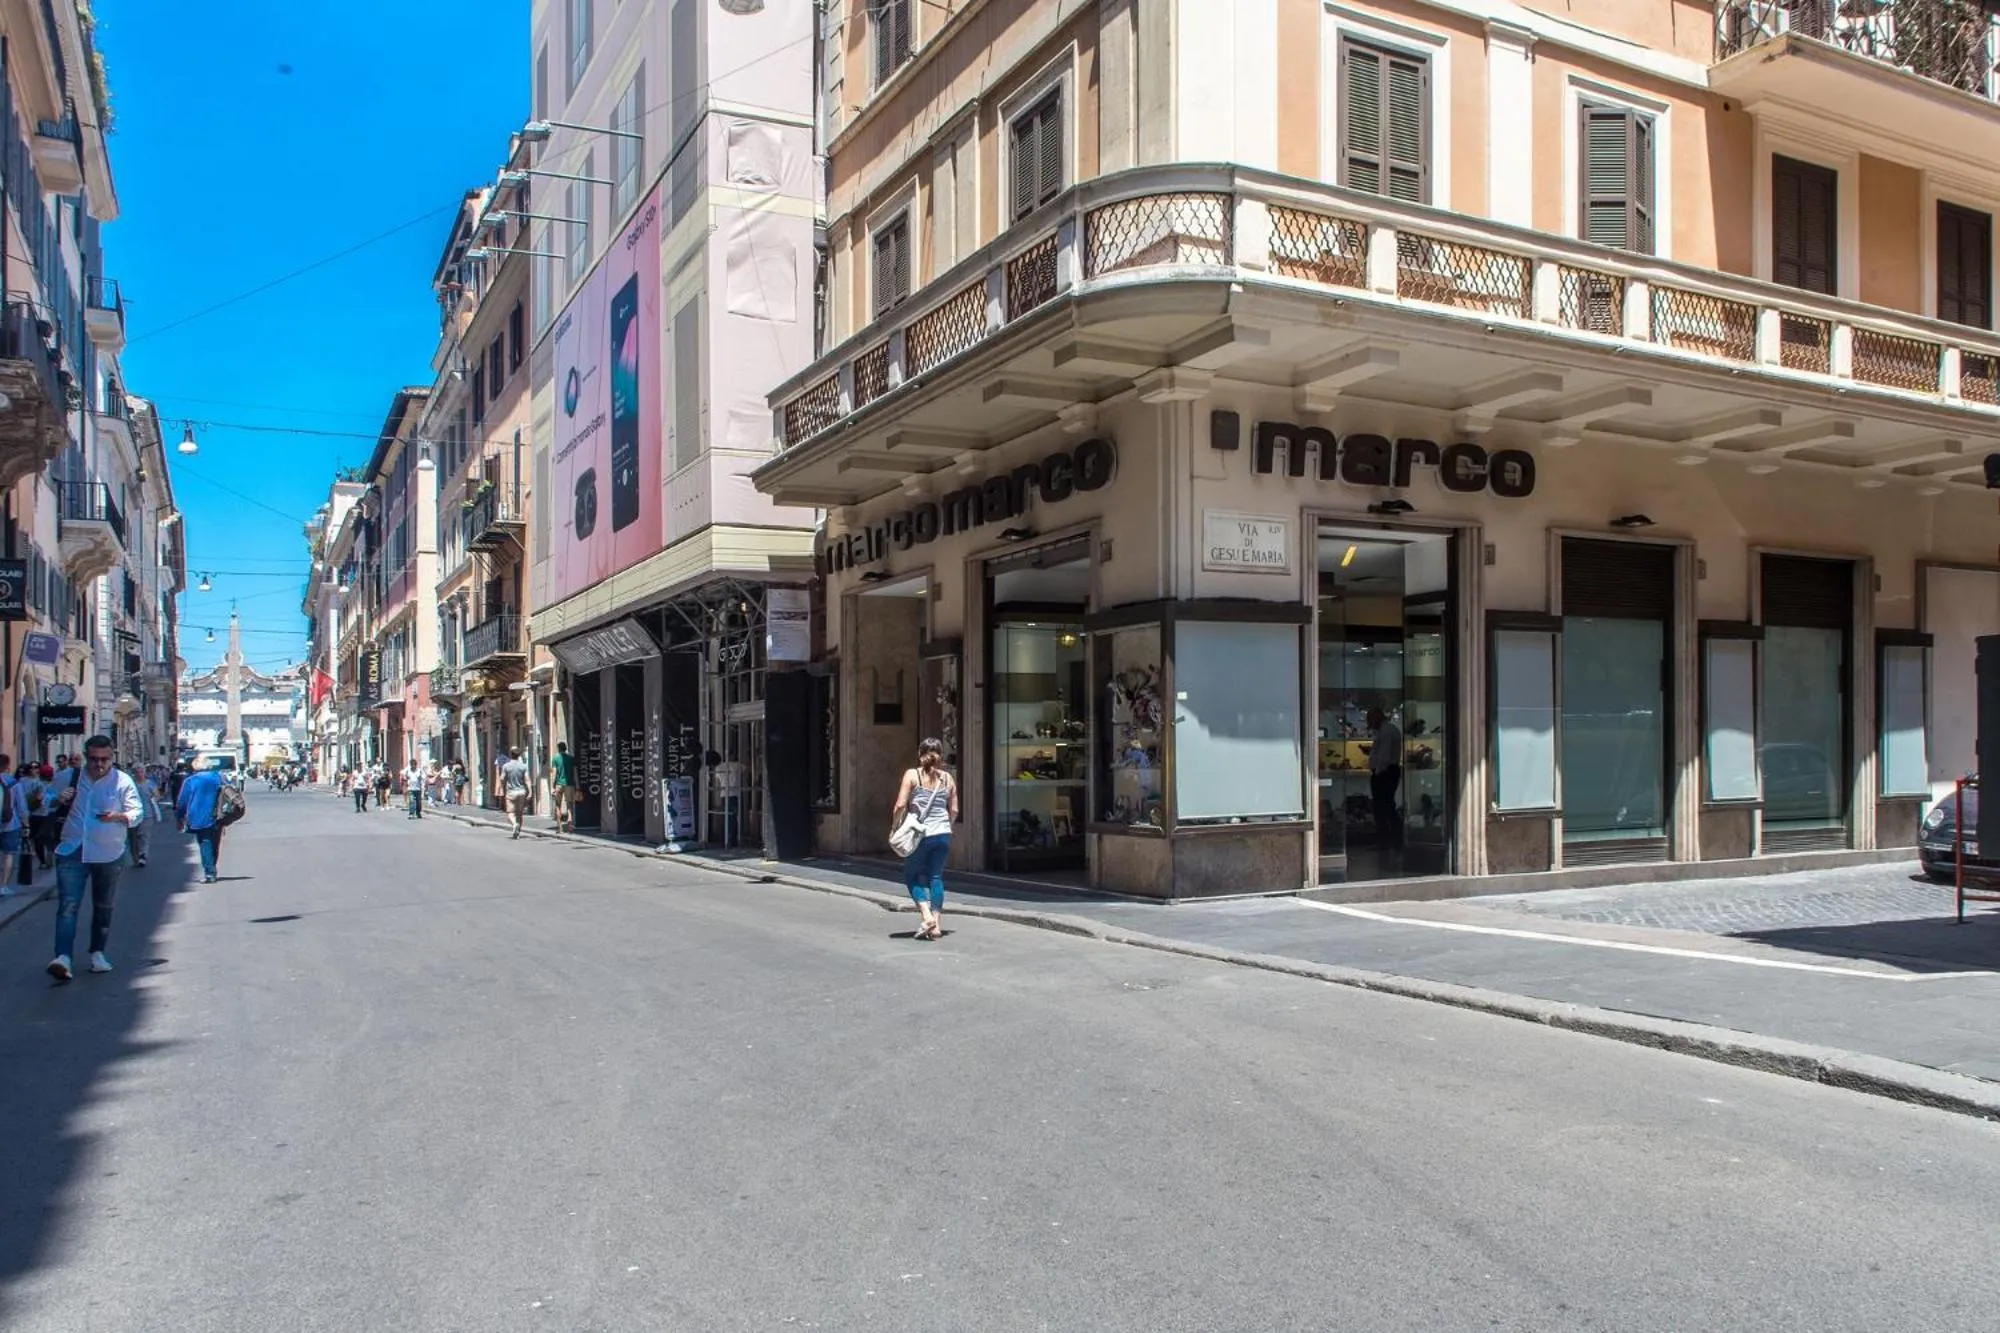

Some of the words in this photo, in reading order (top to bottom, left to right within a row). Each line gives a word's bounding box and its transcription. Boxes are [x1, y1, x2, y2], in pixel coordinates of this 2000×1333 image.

[1252, 421, 1536, 498] marco
[1238, 522, 1258, 536] VIA
[1244, 537, 1253, 547] DI
[1242, 549, 1249, 562] E
[1251, 549, 1284, 563] MARIA
[588, 731, 601, 795] OUTLET
[620, 738, 632, 788] LUXURY
[631, 728, 645, 799] OUTLET
[652, 708, 660, 818] OUTLET
[668, 735, 680, 777] UXURY
